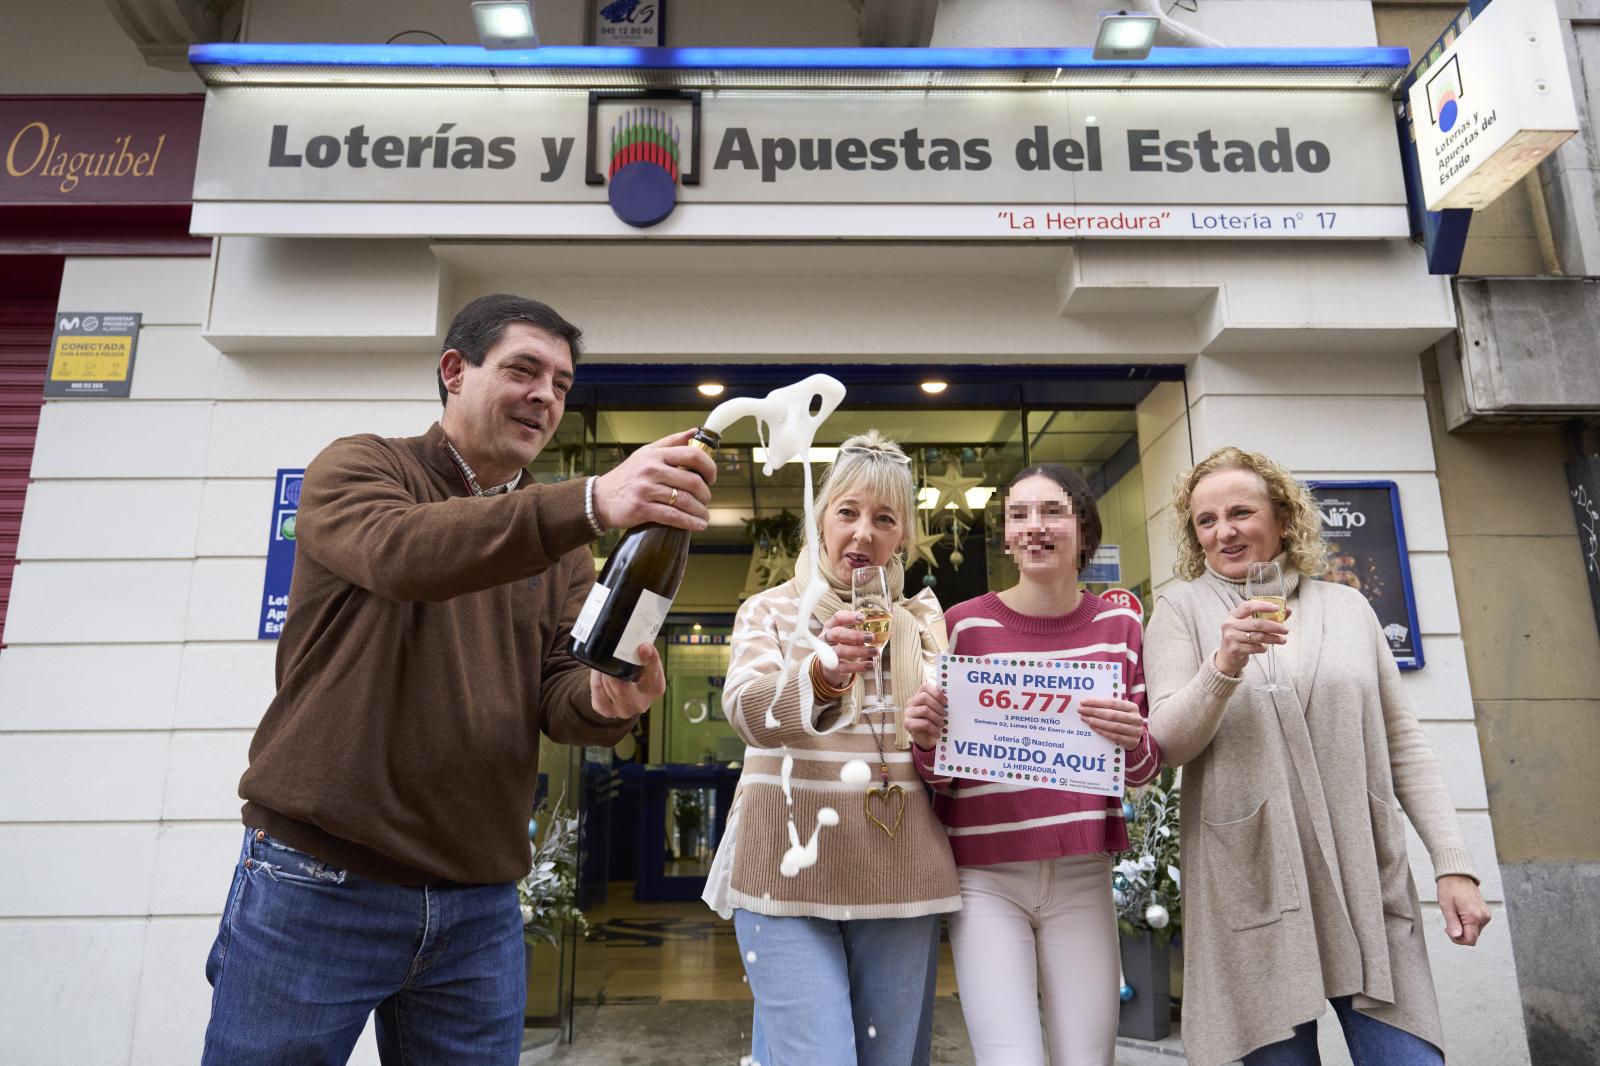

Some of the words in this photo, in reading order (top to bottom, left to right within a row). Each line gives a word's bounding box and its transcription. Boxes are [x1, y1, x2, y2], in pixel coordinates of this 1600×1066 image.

[1473, 112, 1478, 124] y
[1438, 130, 1479, 172] Apuestas
[1481, 109, 1497, 132] del
[6, 121, 165, 192] Olaguibel
[269, 123, 516, 169] Loterías
[540, 136, 575, 182] y
[713, 127, 991, 183] Apuestas
[1016, 126, 1102, 171] del
[1128, 127, 1331, 173] Estado
[1439, 154, 1471, 186] Estado
[1191, 211, 1273, 231] Lotería
[1317, 212, 1337, 231] 17
[61, 342, 125, 350] CONECTADA
[268, 595, 288, 606] Lot
[266, 608, 287, 622] Ap
[967, 670, 1017, 686] GRAN
[1023, 673, 1095, 690] PREMIO
[978, 688, 1072, 714] 66.777
[974, 718, 998, 726] Semana
[1010, 722, 1028, 730] Lunes
[1048, 726, 1066, 734] Enero
[1010, 715, 1039, 723] PREMIO
[1041, 717, 1061, 725] NIÑO
[1032, 738, 1065, 749] Nacional
[954, 740, 1047, 765] VENDIDO
[1052, 752, 1106, 773] AQUÍ
[1003, 762, 1012, 770] LA
[1013, 764, 1057, 775] HERRADURA
